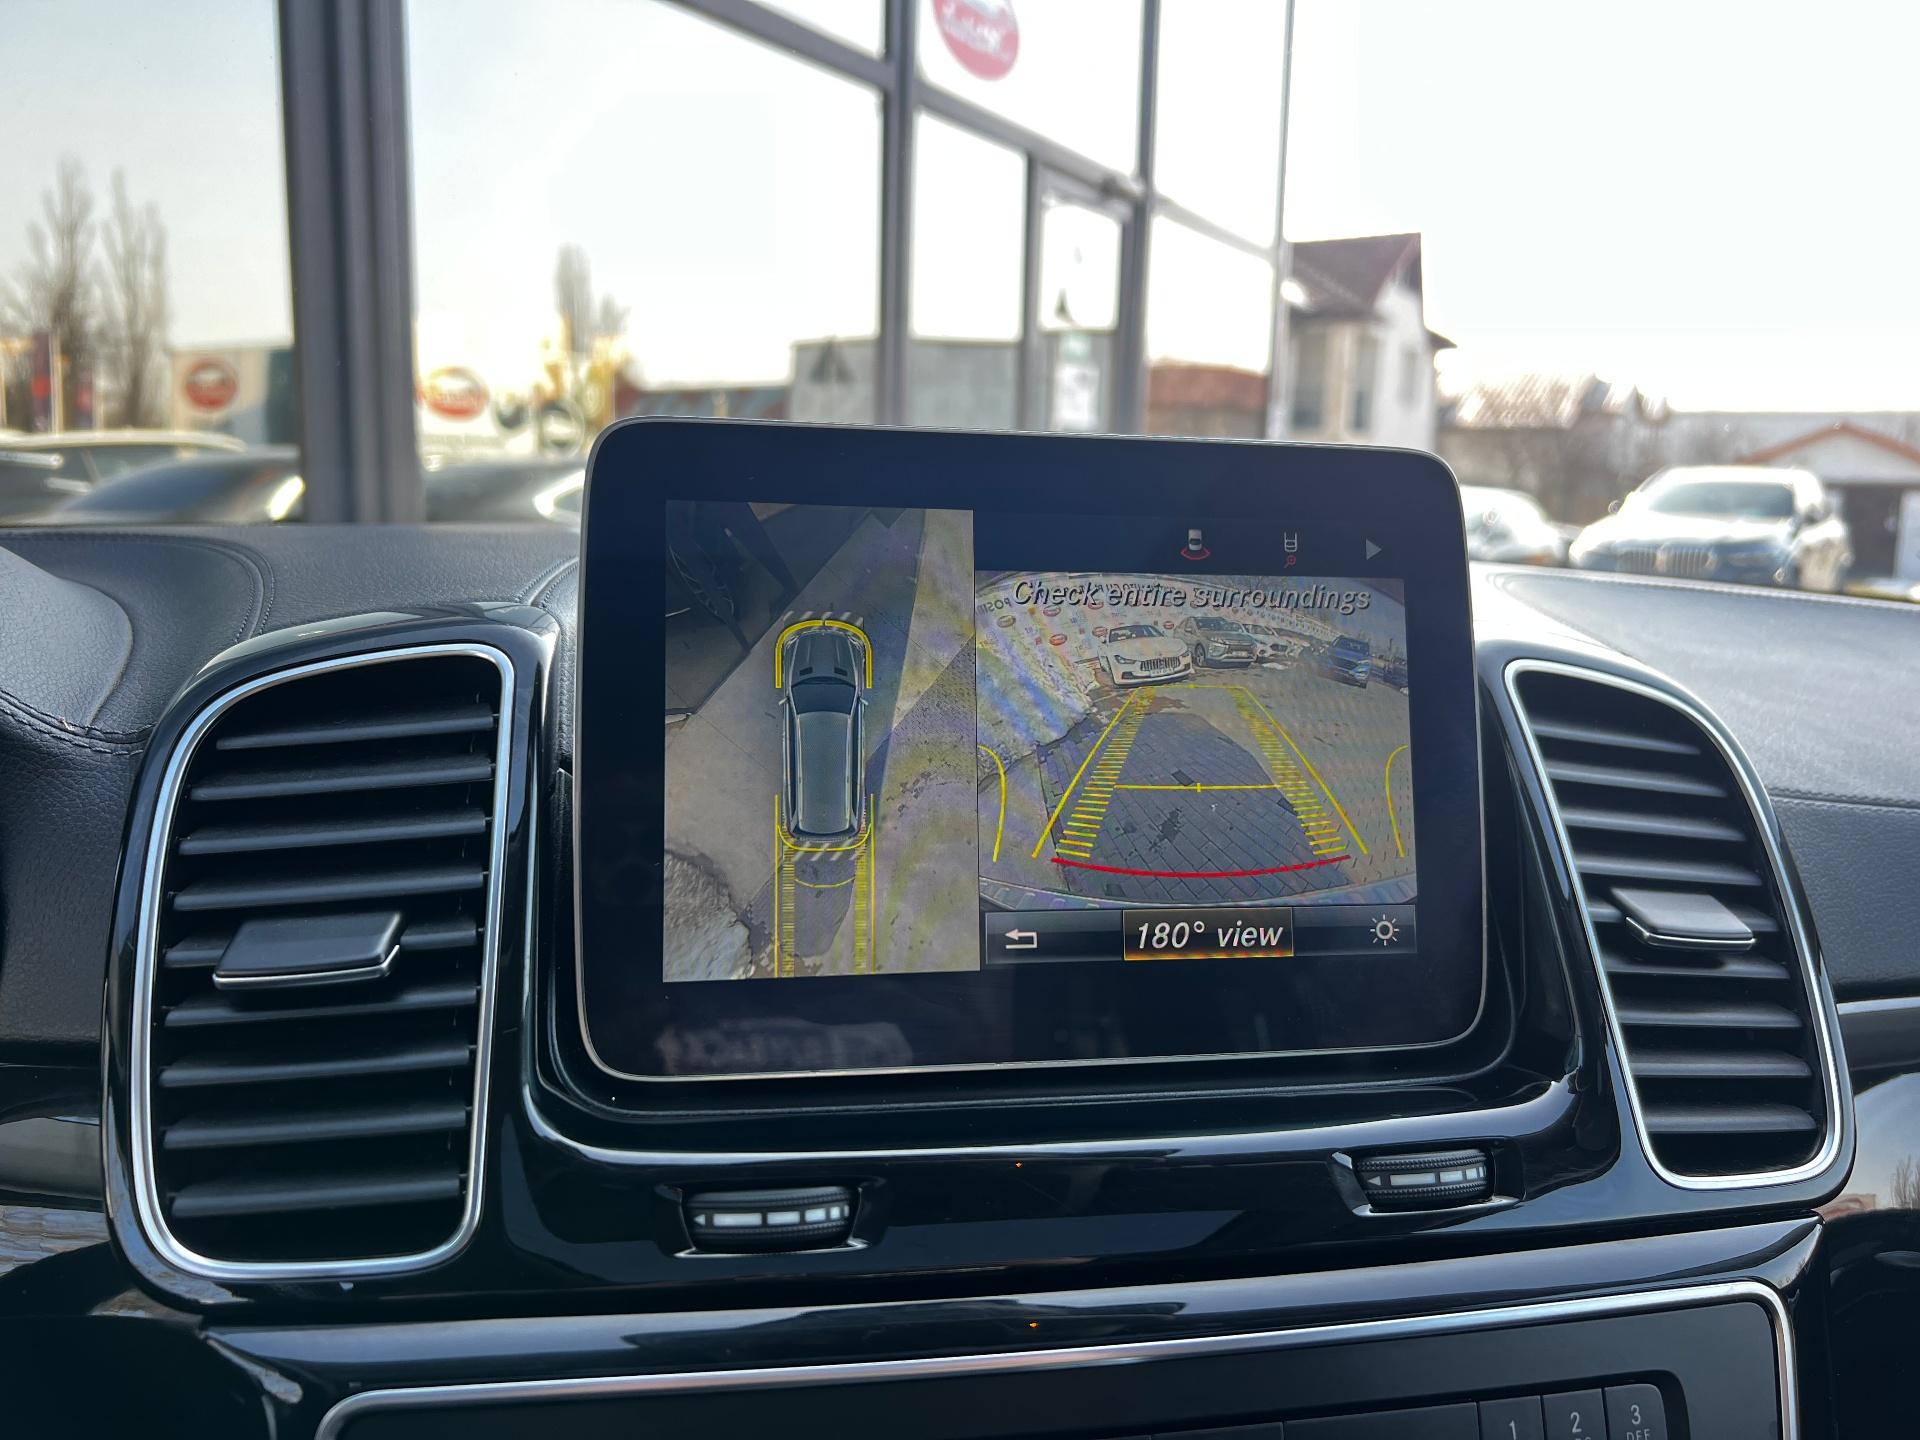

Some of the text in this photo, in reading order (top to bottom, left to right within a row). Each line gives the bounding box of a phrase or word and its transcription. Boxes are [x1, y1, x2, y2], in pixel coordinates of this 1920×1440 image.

[1014, 580, 1371, 615] Check entire surroundings
[1138, 920, 1284, 949] 180° view
[1570, 1411, 1582, 1433] 2
[1630, 1404, 1641, 1425] 3
[1508, 1420, 1517, 1440] 1
